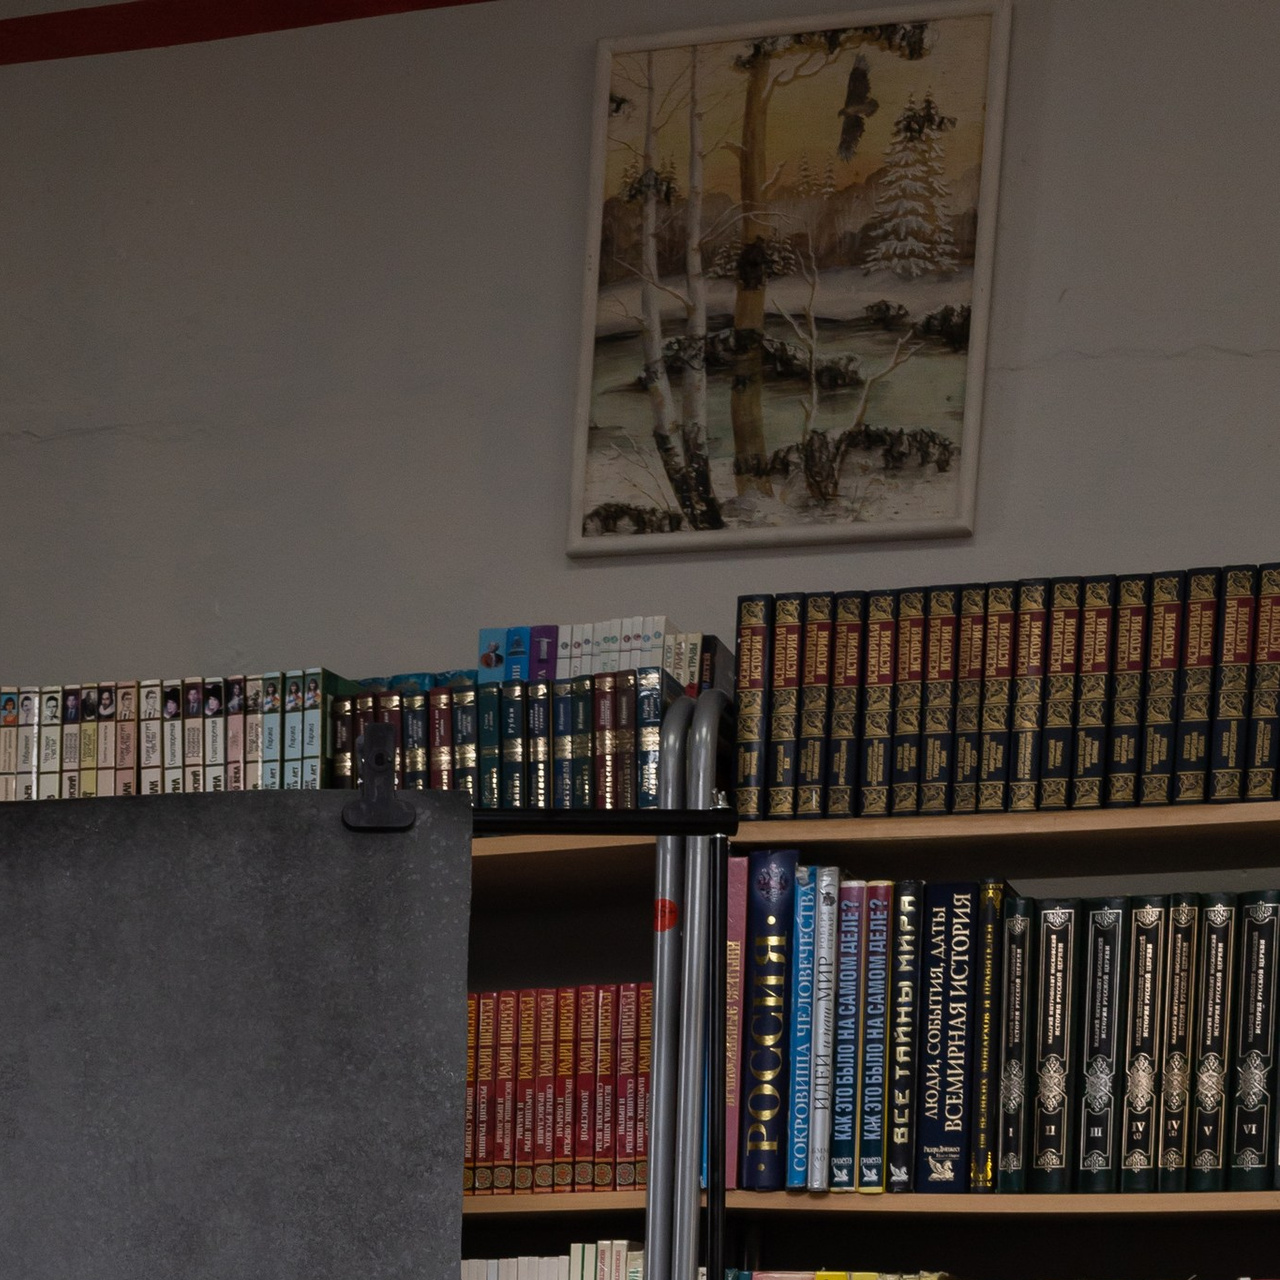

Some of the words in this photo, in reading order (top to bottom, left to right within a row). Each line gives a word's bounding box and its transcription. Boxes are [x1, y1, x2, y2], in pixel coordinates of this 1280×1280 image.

[1223, 600, 1237, 662] ВСЕМИРНАЯ
[1236, 607, 1249, 653] ИСТОРИЯ
[897, 896, 916, 971] МИРА
[931, 907, 946, 958] ДАТЫ
[949, 893, 970, 996] ИСТОРИЯ
[797, 884, 814, 1036] ЧЕЛОВЕЧЕСТВА
[869, 956, 886, 1014] САМОМ
[840, 957, 857, 1014] САМОМ
[928, 963, 945, 1055] СОБЫТИЯ,
[747, 936, 786, 1154] РОССИЯ
[839, 1018, 855, 1039] НА
[869, 1018, 885, 1039] НА
[894, 981, 912, 1080] ТАЙНЫ
[837, 1045, 855, 1084] БЫЛО
[866, 1044, 884, 1083] БЫЛО
[945, 1003, 966, 1131] ВСЕМИРНАЯ
[478, 1086, 487, 1120] РУССКИЙ
[794, 1044, 810, 1171] СОКРОВИЩА
[836, 1089, 853, 1112] ЭТО
[865, 1088, 882, 1111] ЭТО
[925, 1060, 942, 1119] ЛЮДИ,
[580, 1090, 590, 1140] ДОМОСТРОЙ
[835, 1116, 852, 1140] КАК
[864, 1115, 881, 1140] КАК
[893, 1089, 910, 1143] ВСЕ
[1045, 1125, 1055, 1135] II
[1090, 1127, 1102, 1137] III
[1243, 1124, 1257, 1134] VI
[478, 1123, 486, 1158] ТРАВНИК
